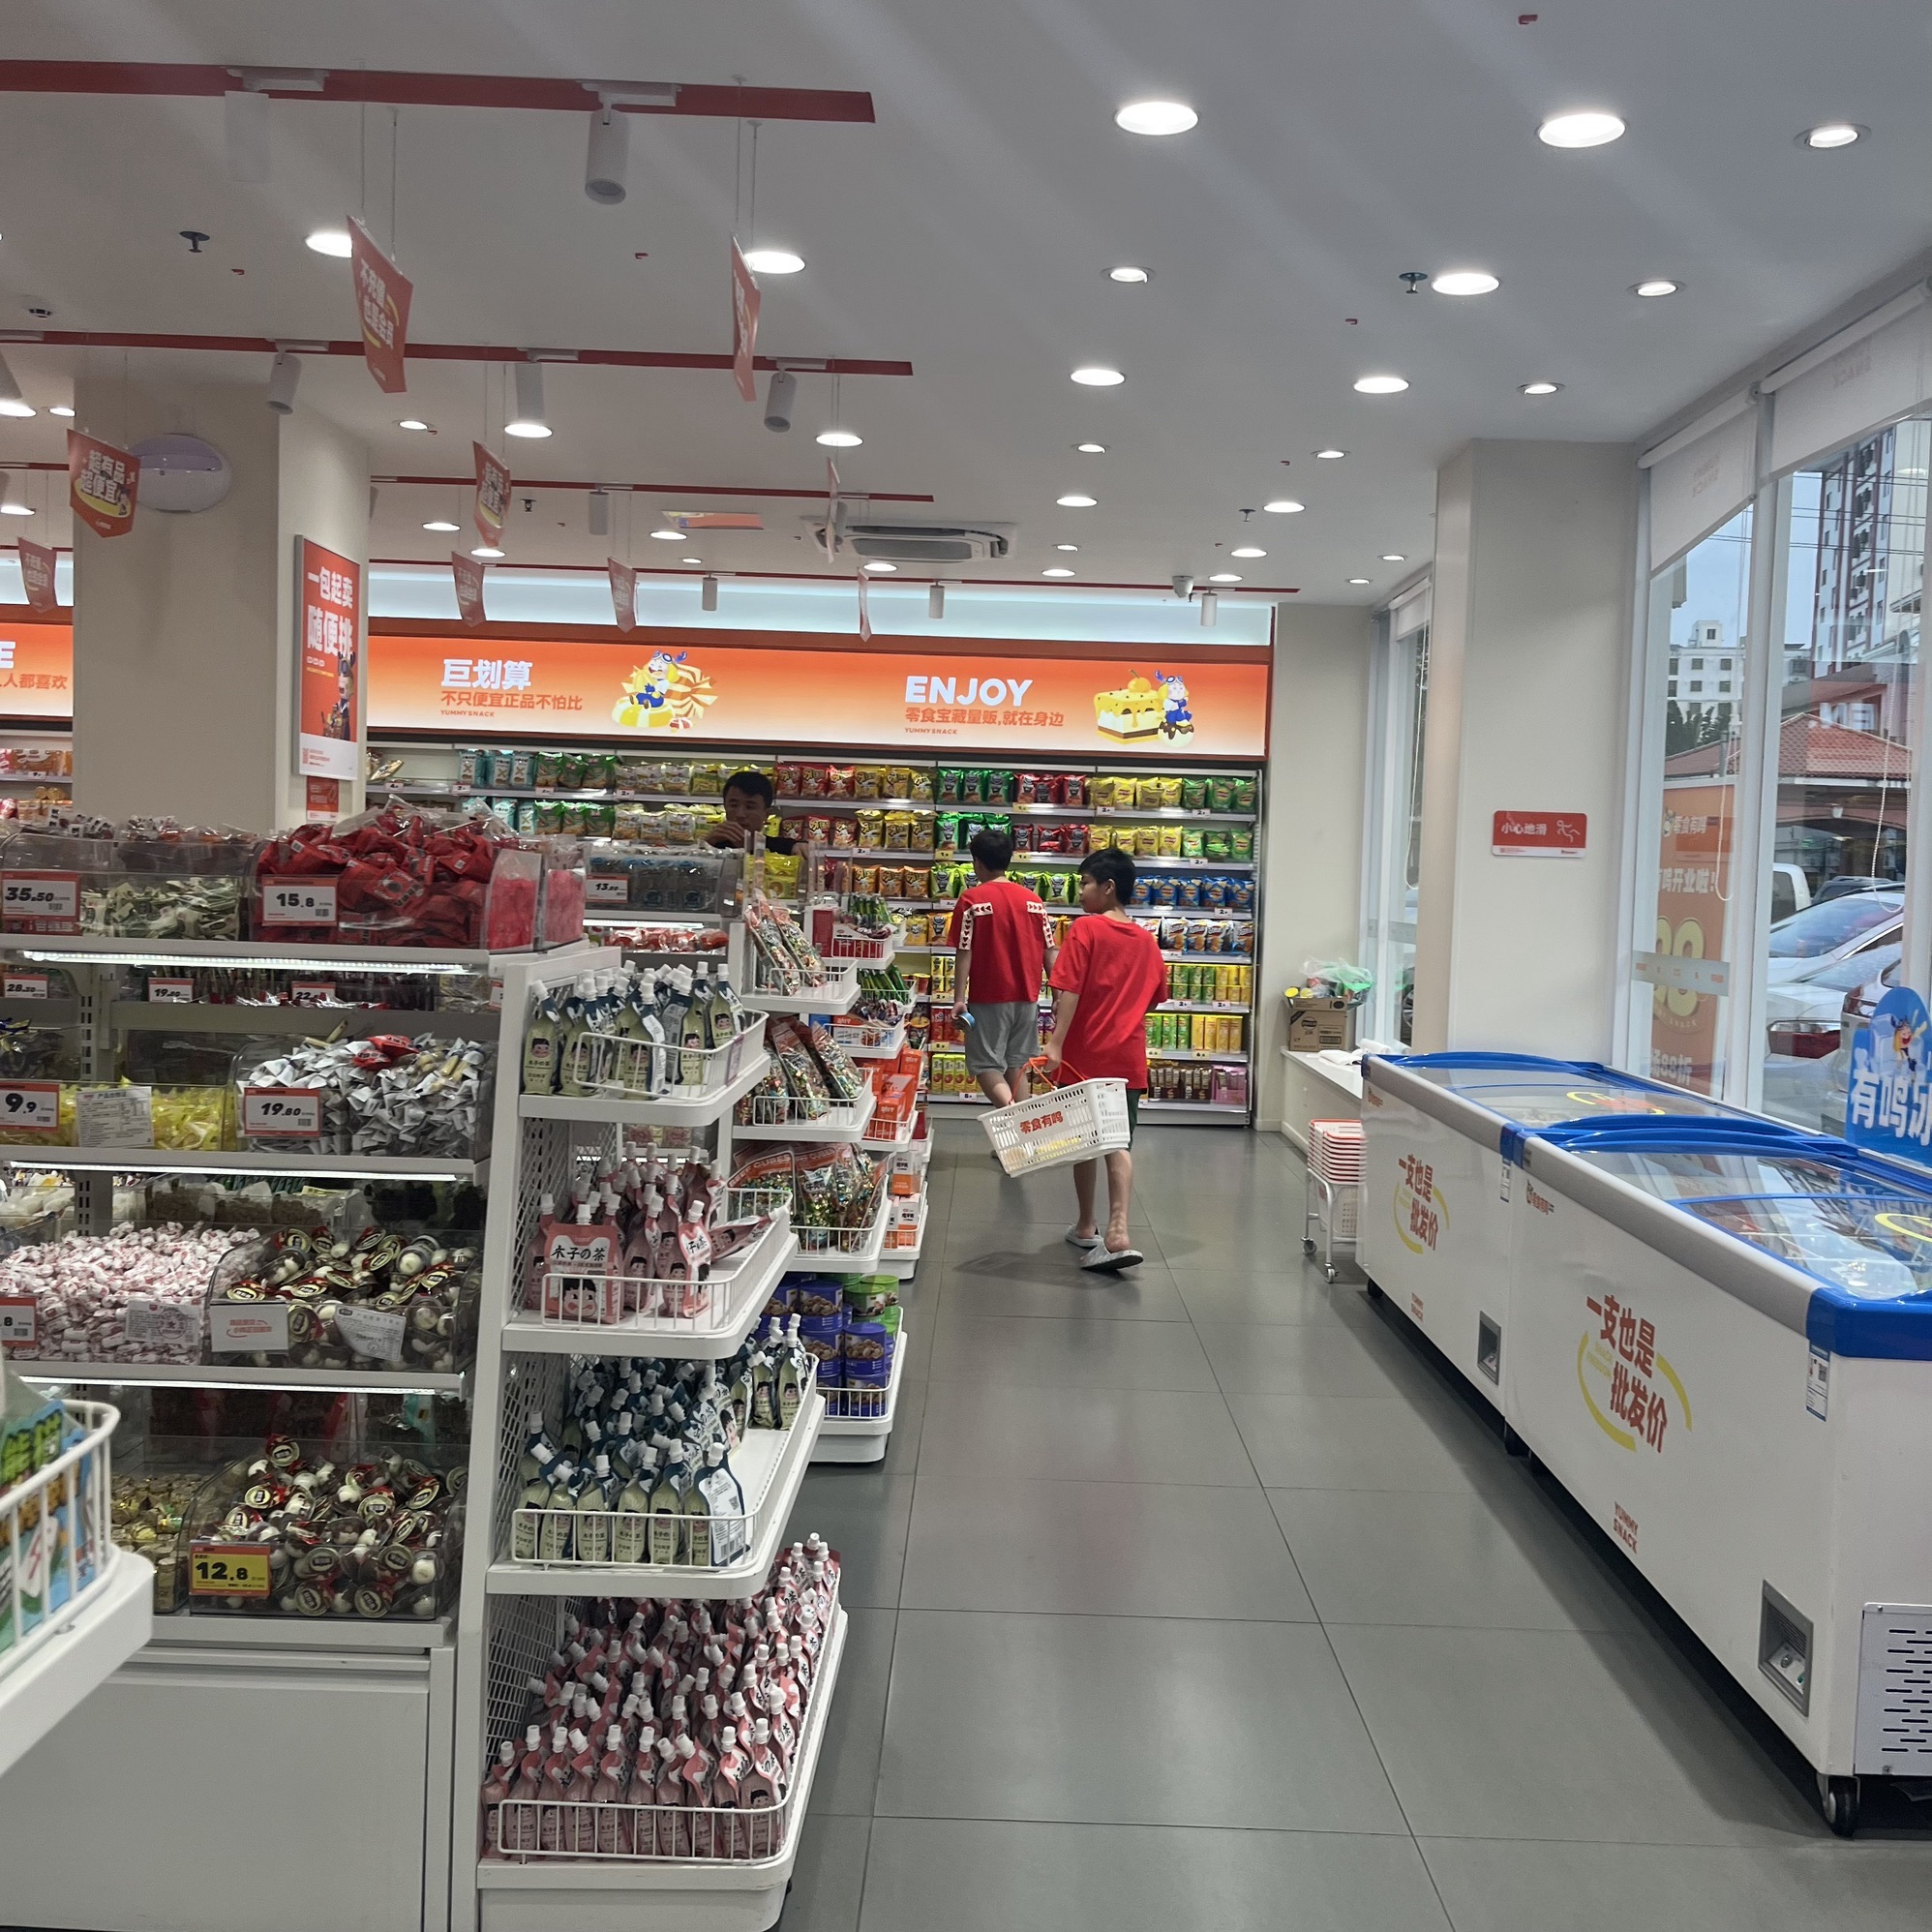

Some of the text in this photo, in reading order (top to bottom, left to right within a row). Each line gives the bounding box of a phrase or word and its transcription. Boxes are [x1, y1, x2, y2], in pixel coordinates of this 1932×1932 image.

[308, 566, 353, 610] 一包起卖
[307, 604, 353, 658] 随便挑
[0, 673, 68, 690] 人都喜欢
[440, 659, 533, 691] 巨划算
[440, 690, 584, 710] 不只便宜正品不怕比
[905, 676, 1033, 707] ENJOY
[905, 707, 1064, 727] 零食宝藏量贩,就在身边
[1501, 822, 1547, 835] 小心地滑
[5, 887, 54, 901] 35.50
[276, 893, 315, 908] 15.8
[5, 1093, 37, 1114] 9.9
[261, 1102, 301, 1116] 19.80
[1019, 1111, 1064, 1133] 零食有鸣
[1398, 1154, 1434, 1203] 一支也是
[1410, 1196, 1438, 1251] 批发价
[551, 1245, 607, 1261] 木子の茶
[1586, 1294, 1655, 1378] 一支也是
[1611, 1360, 1668, 1454] 批发价
[196, 1562, 248, 1581] 12.8
